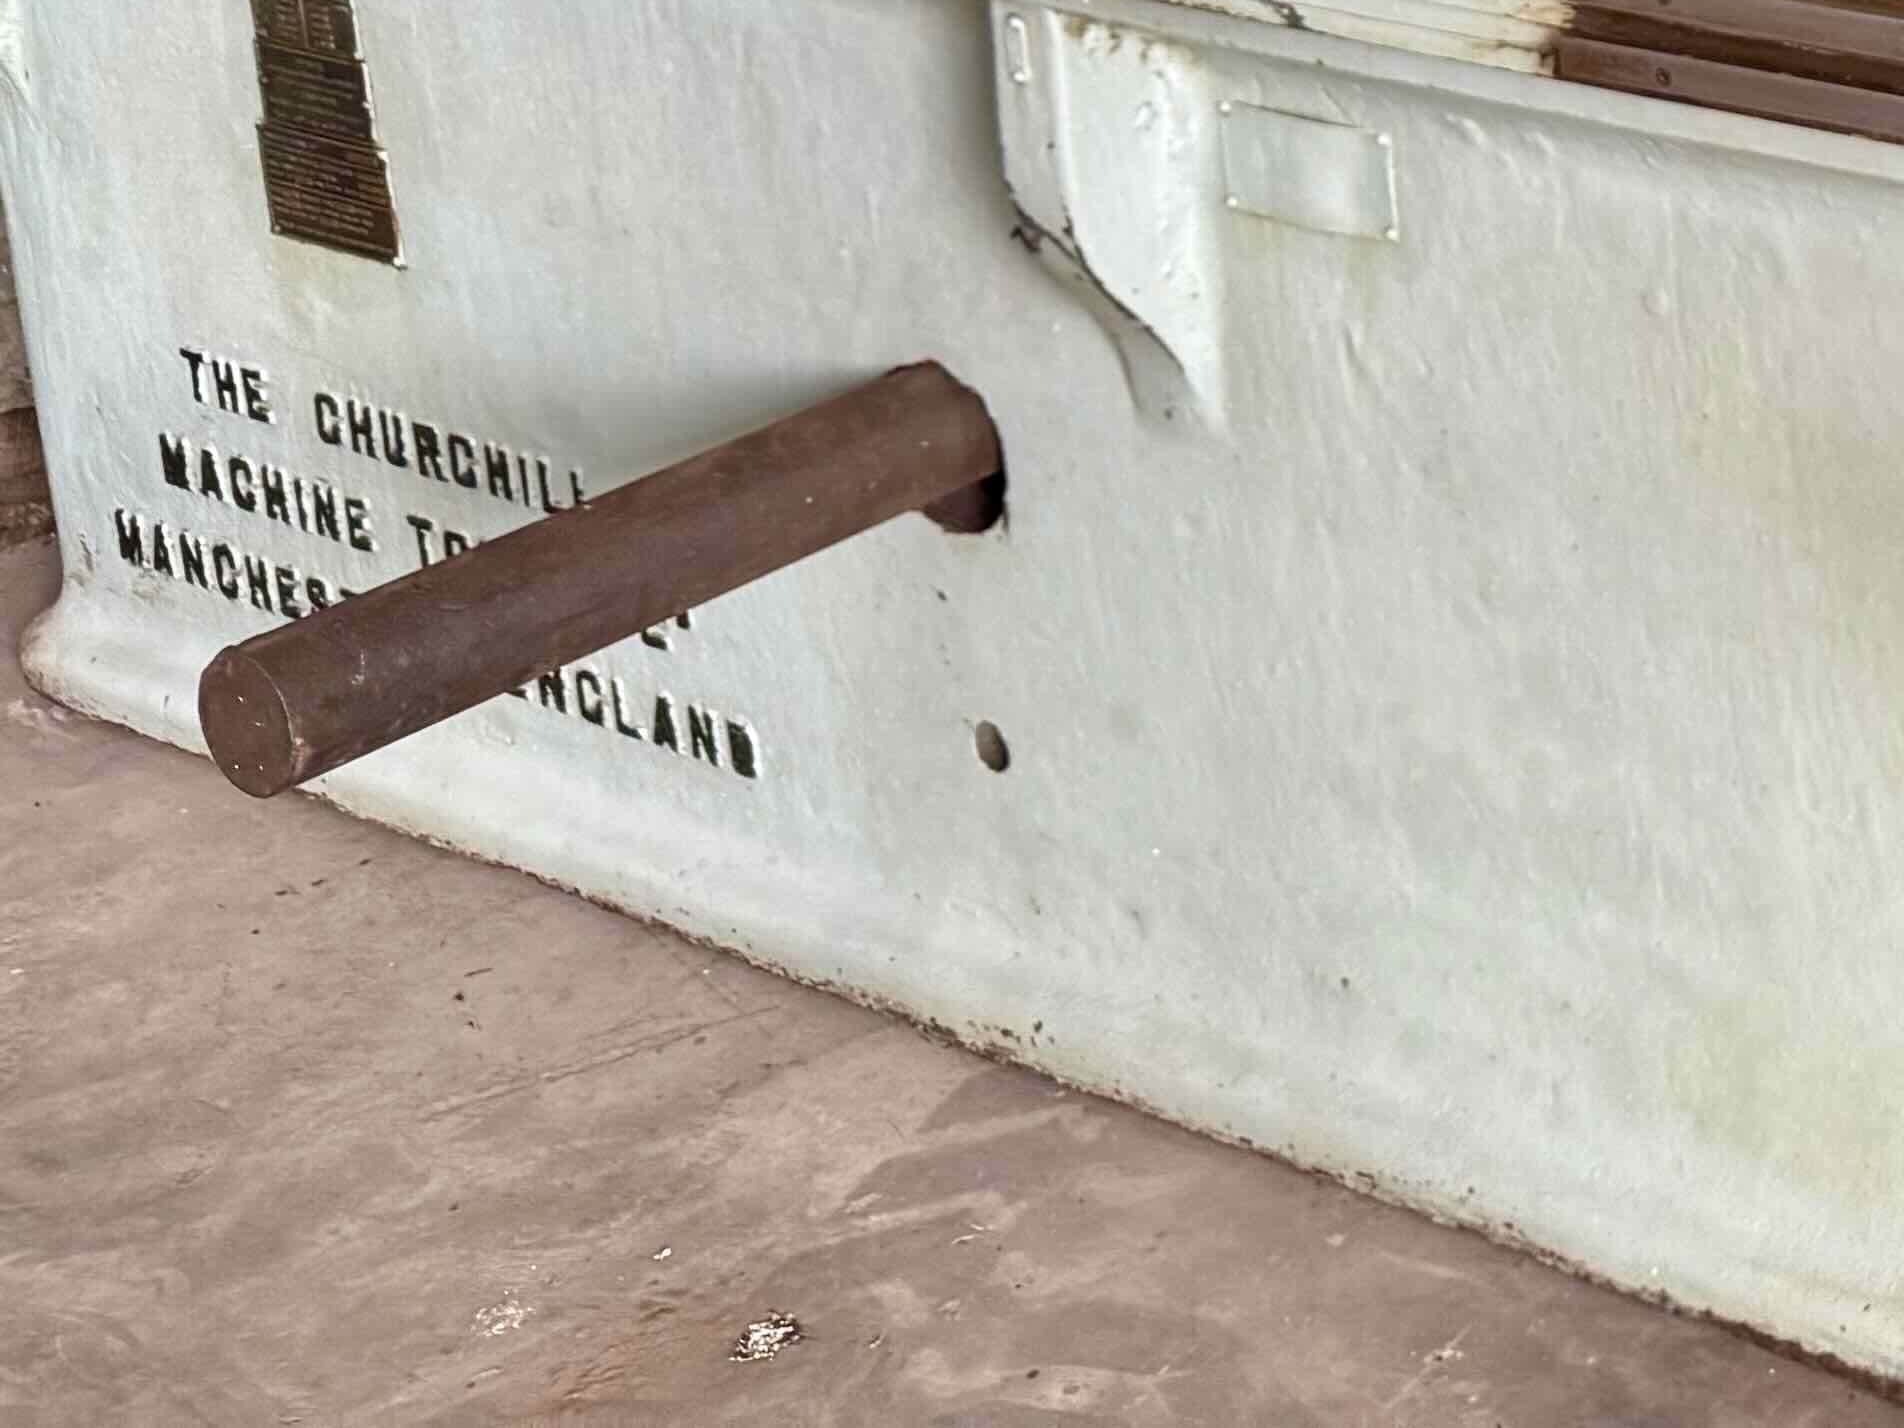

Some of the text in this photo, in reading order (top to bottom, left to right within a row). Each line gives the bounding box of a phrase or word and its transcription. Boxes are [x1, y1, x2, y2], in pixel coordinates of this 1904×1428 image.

[179, 347, 271, 423] THE
[159, 433, 377, 552] MACHINE
[114, 508, 362, 620] MANCHES
[506, 668, 758, 780] NGLAND
